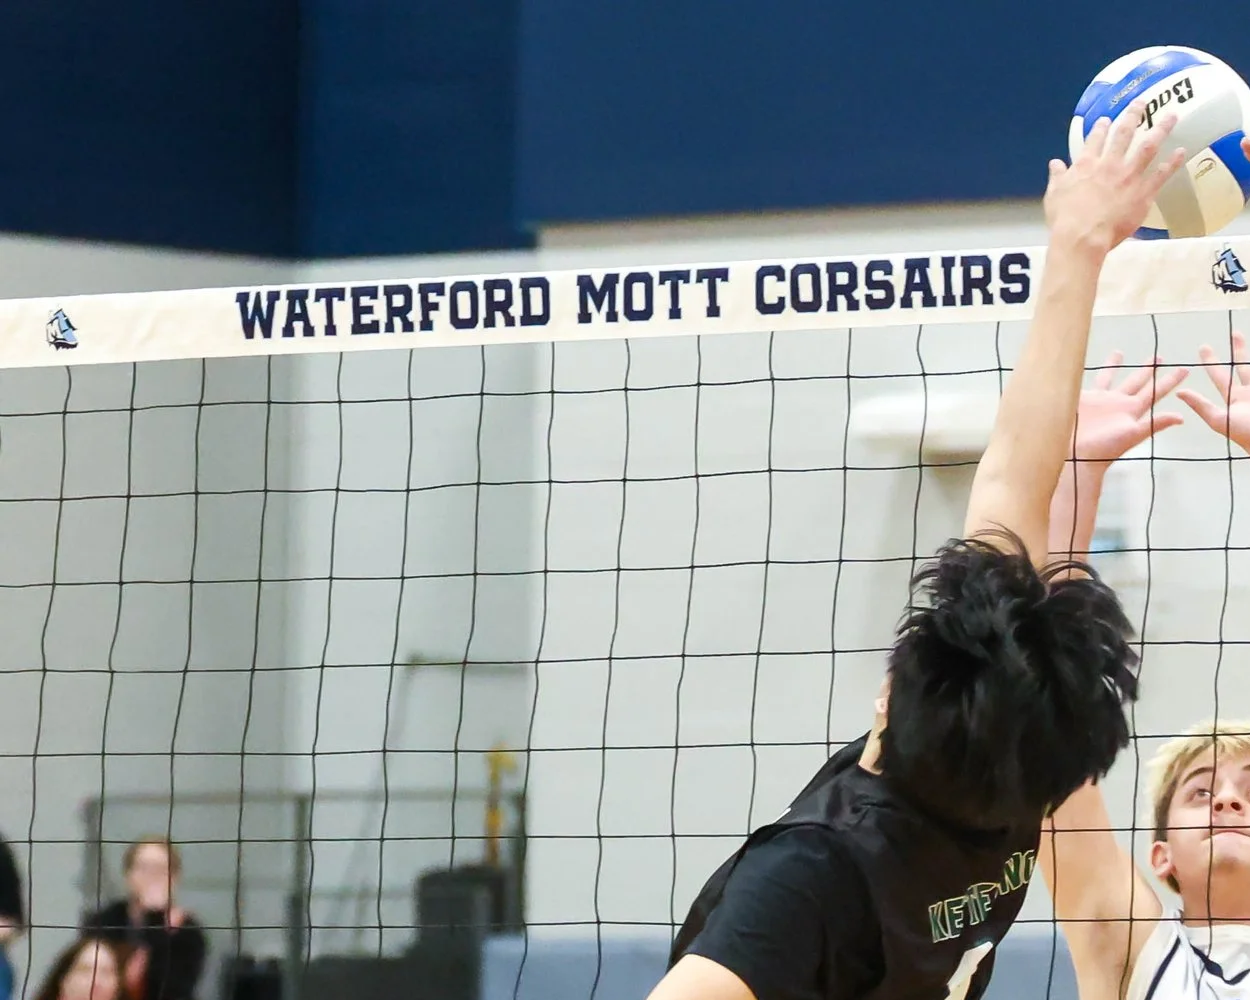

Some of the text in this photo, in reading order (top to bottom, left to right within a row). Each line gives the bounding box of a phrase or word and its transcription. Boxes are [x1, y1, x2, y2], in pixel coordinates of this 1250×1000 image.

[235, 252, 1031, 340] WATERFORD MOTT CORSAIRS
